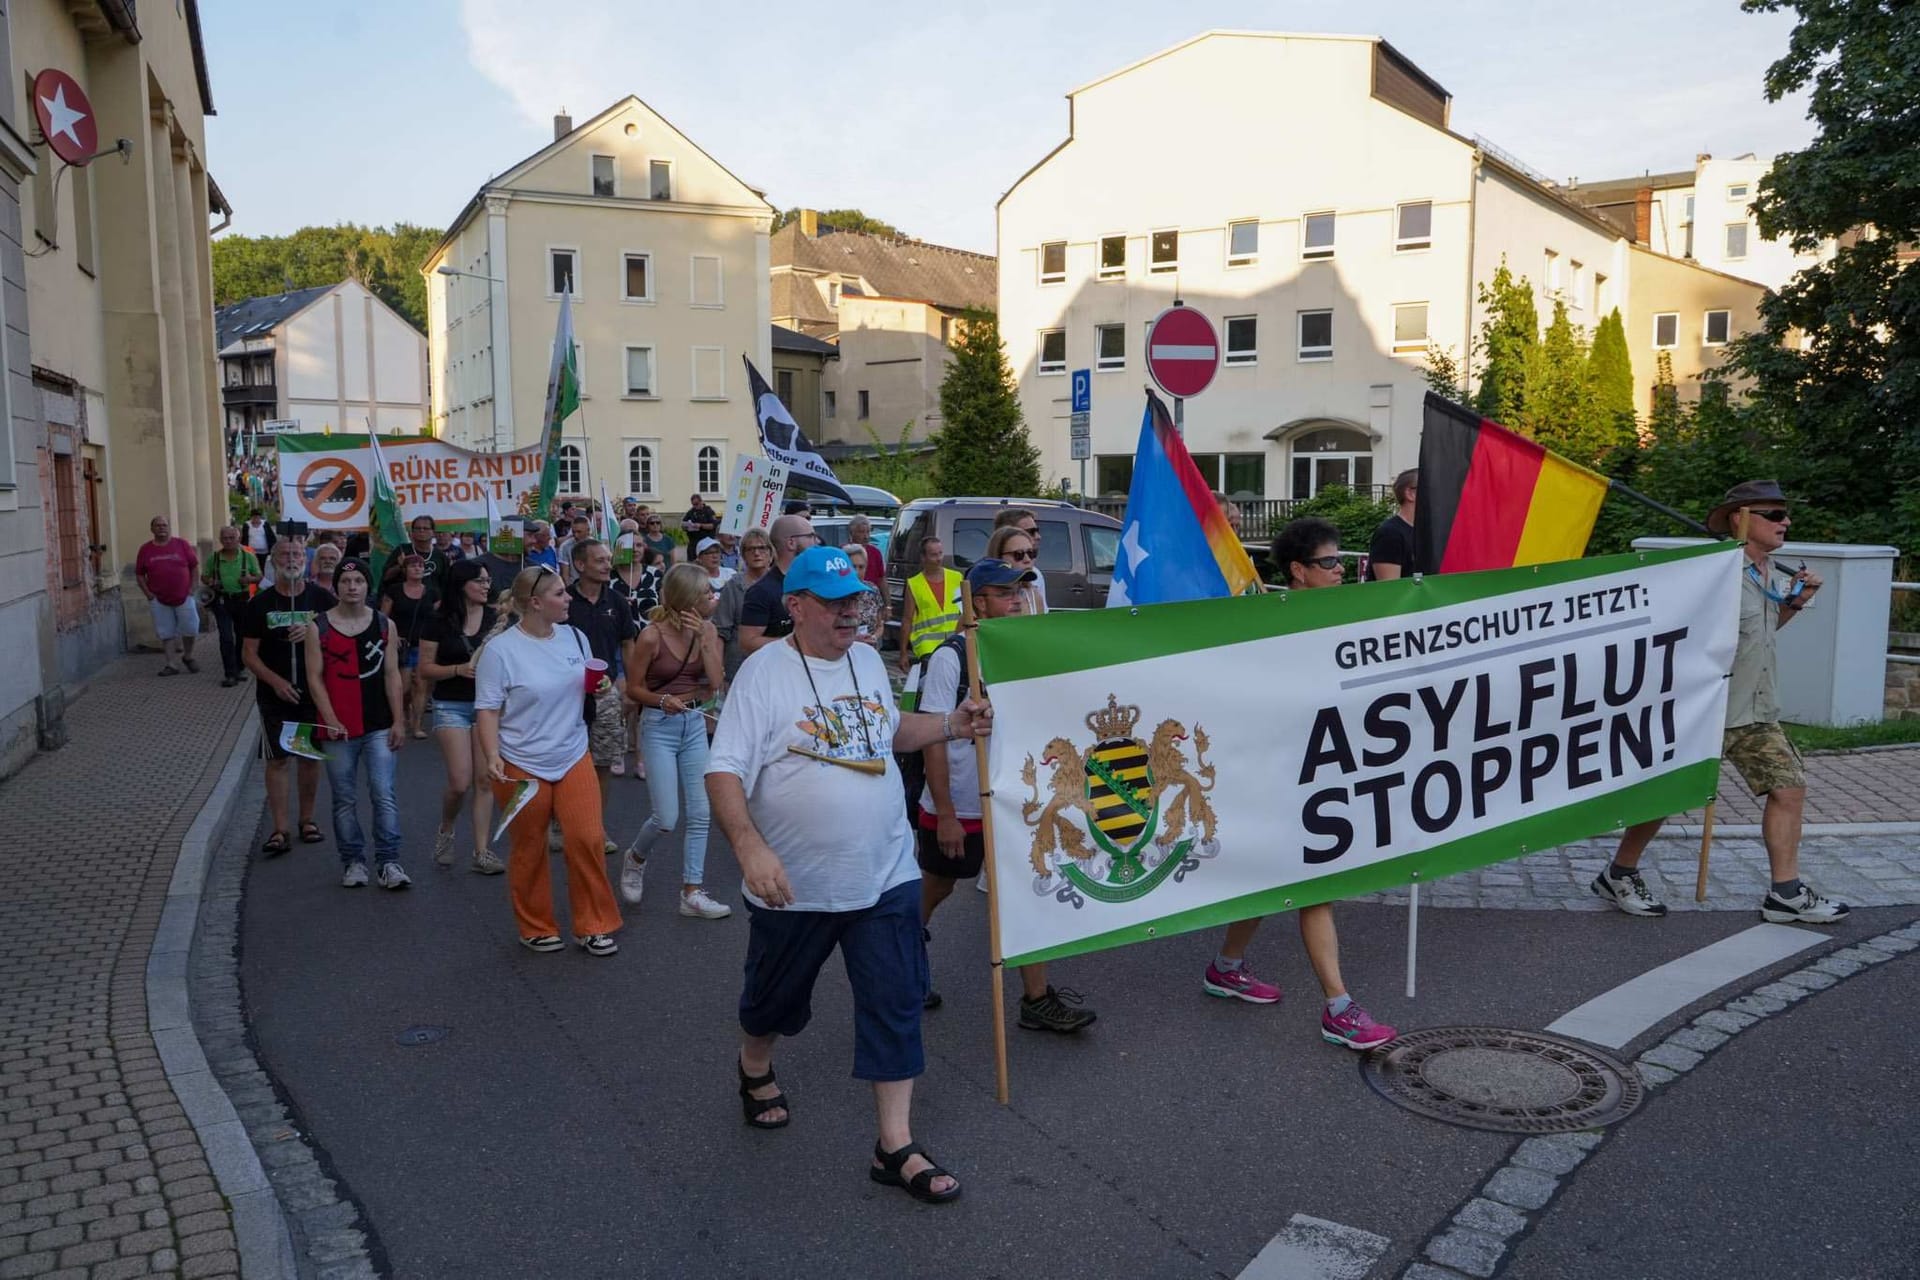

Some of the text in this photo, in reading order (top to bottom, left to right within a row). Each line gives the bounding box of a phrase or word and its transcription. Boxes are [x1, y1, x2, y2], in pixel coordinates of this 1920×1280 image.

[1075, 375, 1086, 408] P
[388, 455, 459, 482] RÜNE
[467, 454, 503, 478] AN
[769, 465, 781, 478] in
[394, 479, 512, 506] STFRONT!
[734, 460, 753, 529] Ampel
[762, 479, 783, 491] den
[760, 491, 775, 527] Knas
[825, 556, 848, 573] AfD
[1335, 583, 1649, 669] GRENZSCHUTZ JETZT:
[1299, 626, 1689, 785] ASYLFLUT
[1301, 699, 1676, 864] STOPPEN!
